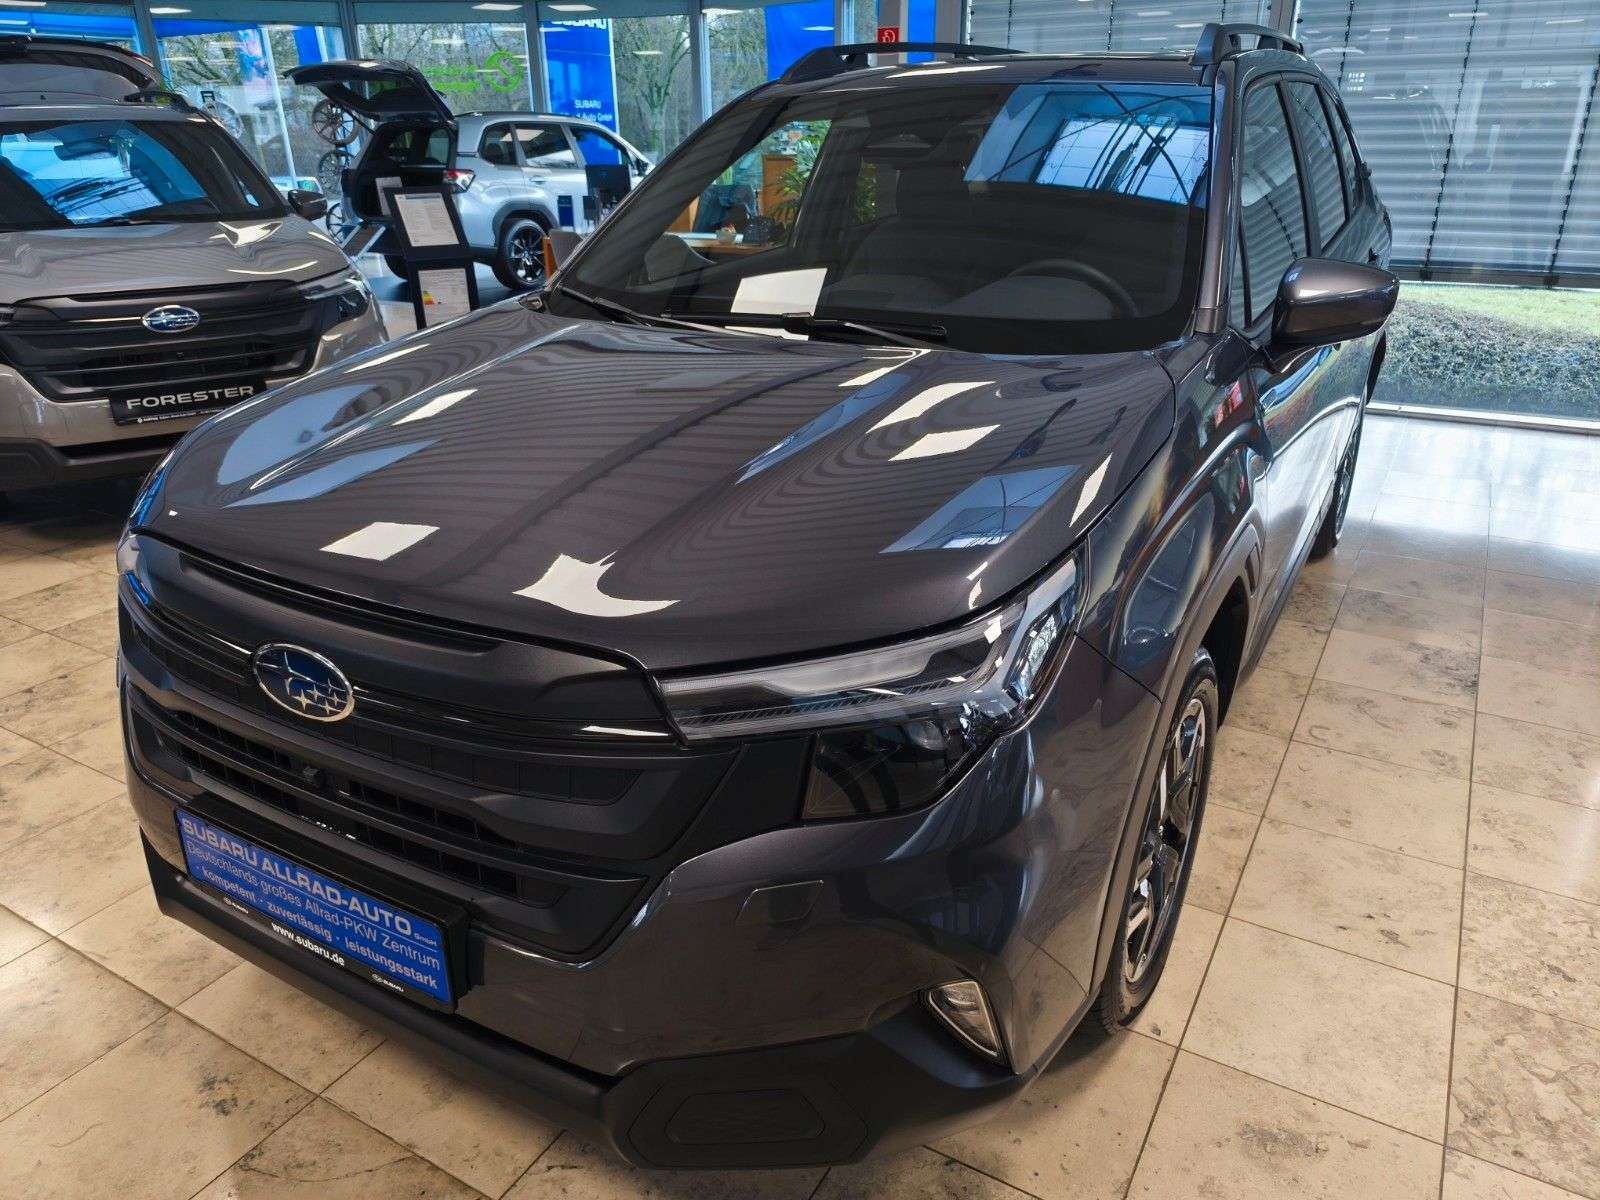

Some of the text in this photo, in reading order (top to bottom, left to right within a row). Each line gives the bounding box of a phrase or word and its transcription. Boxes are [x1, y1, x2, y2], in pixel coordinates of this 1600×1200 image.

[575, 99, 602, 109] SUBARU
[126, 385, 254, 410] FORESTER
[182, 818, 258, 868] SUBARU
[262, 857, 412, 936] ALLRAD-AUTO
[187, 841, 440, 971] Deutschlands großes Allrad-PKW Zentrum
[267, 902, 333, 942] zuverlässig
[344, 936, 438, 989] leistungsstark
[271, 922, 345, 967] www.subaru.de
